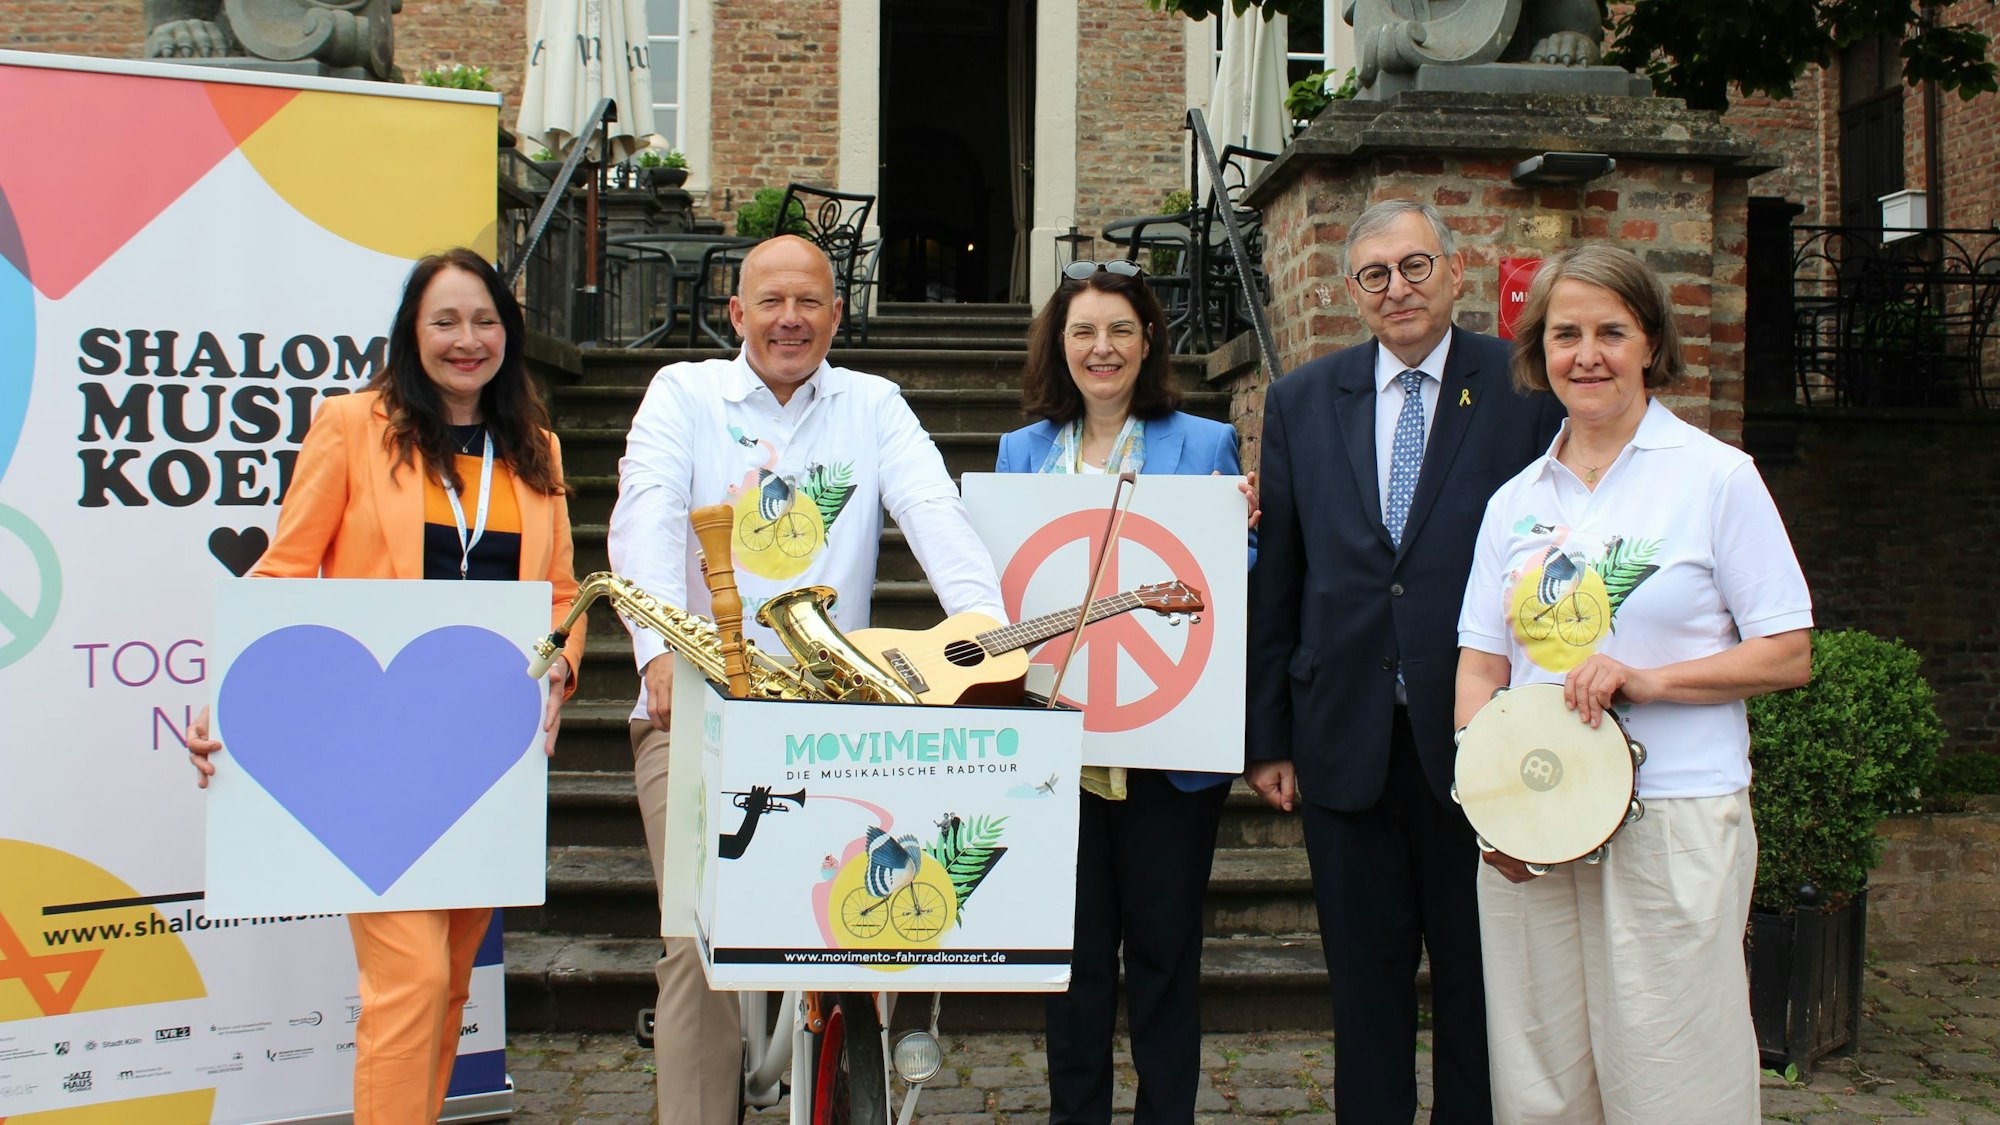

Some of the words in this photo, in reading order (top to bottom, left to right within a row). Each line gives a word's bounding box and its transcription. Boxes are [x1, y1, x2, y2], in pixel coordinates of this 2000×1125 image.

[78, 327, 389, 381] SHALOM
[77, 382, 351, 444] MUSI
[73, 639, 206, 689] TOG
[153, 705, 191, 751] N
[785, 727, 1020, 766] MOVIMENTO
[786, 770, 811, 780] DIE
[821, 766, 937, 780] MUSIKALISCHE
[947, 763, 1018, 775] RADTOUR
[784, 951, 1007, 963] www.movimento-fahrradkonzert.de
[102, 1040, 124, 1049] Stadt
[156, 1029, 178, 1039] LVR
[63, 1079, 93, 1089] HAUS
